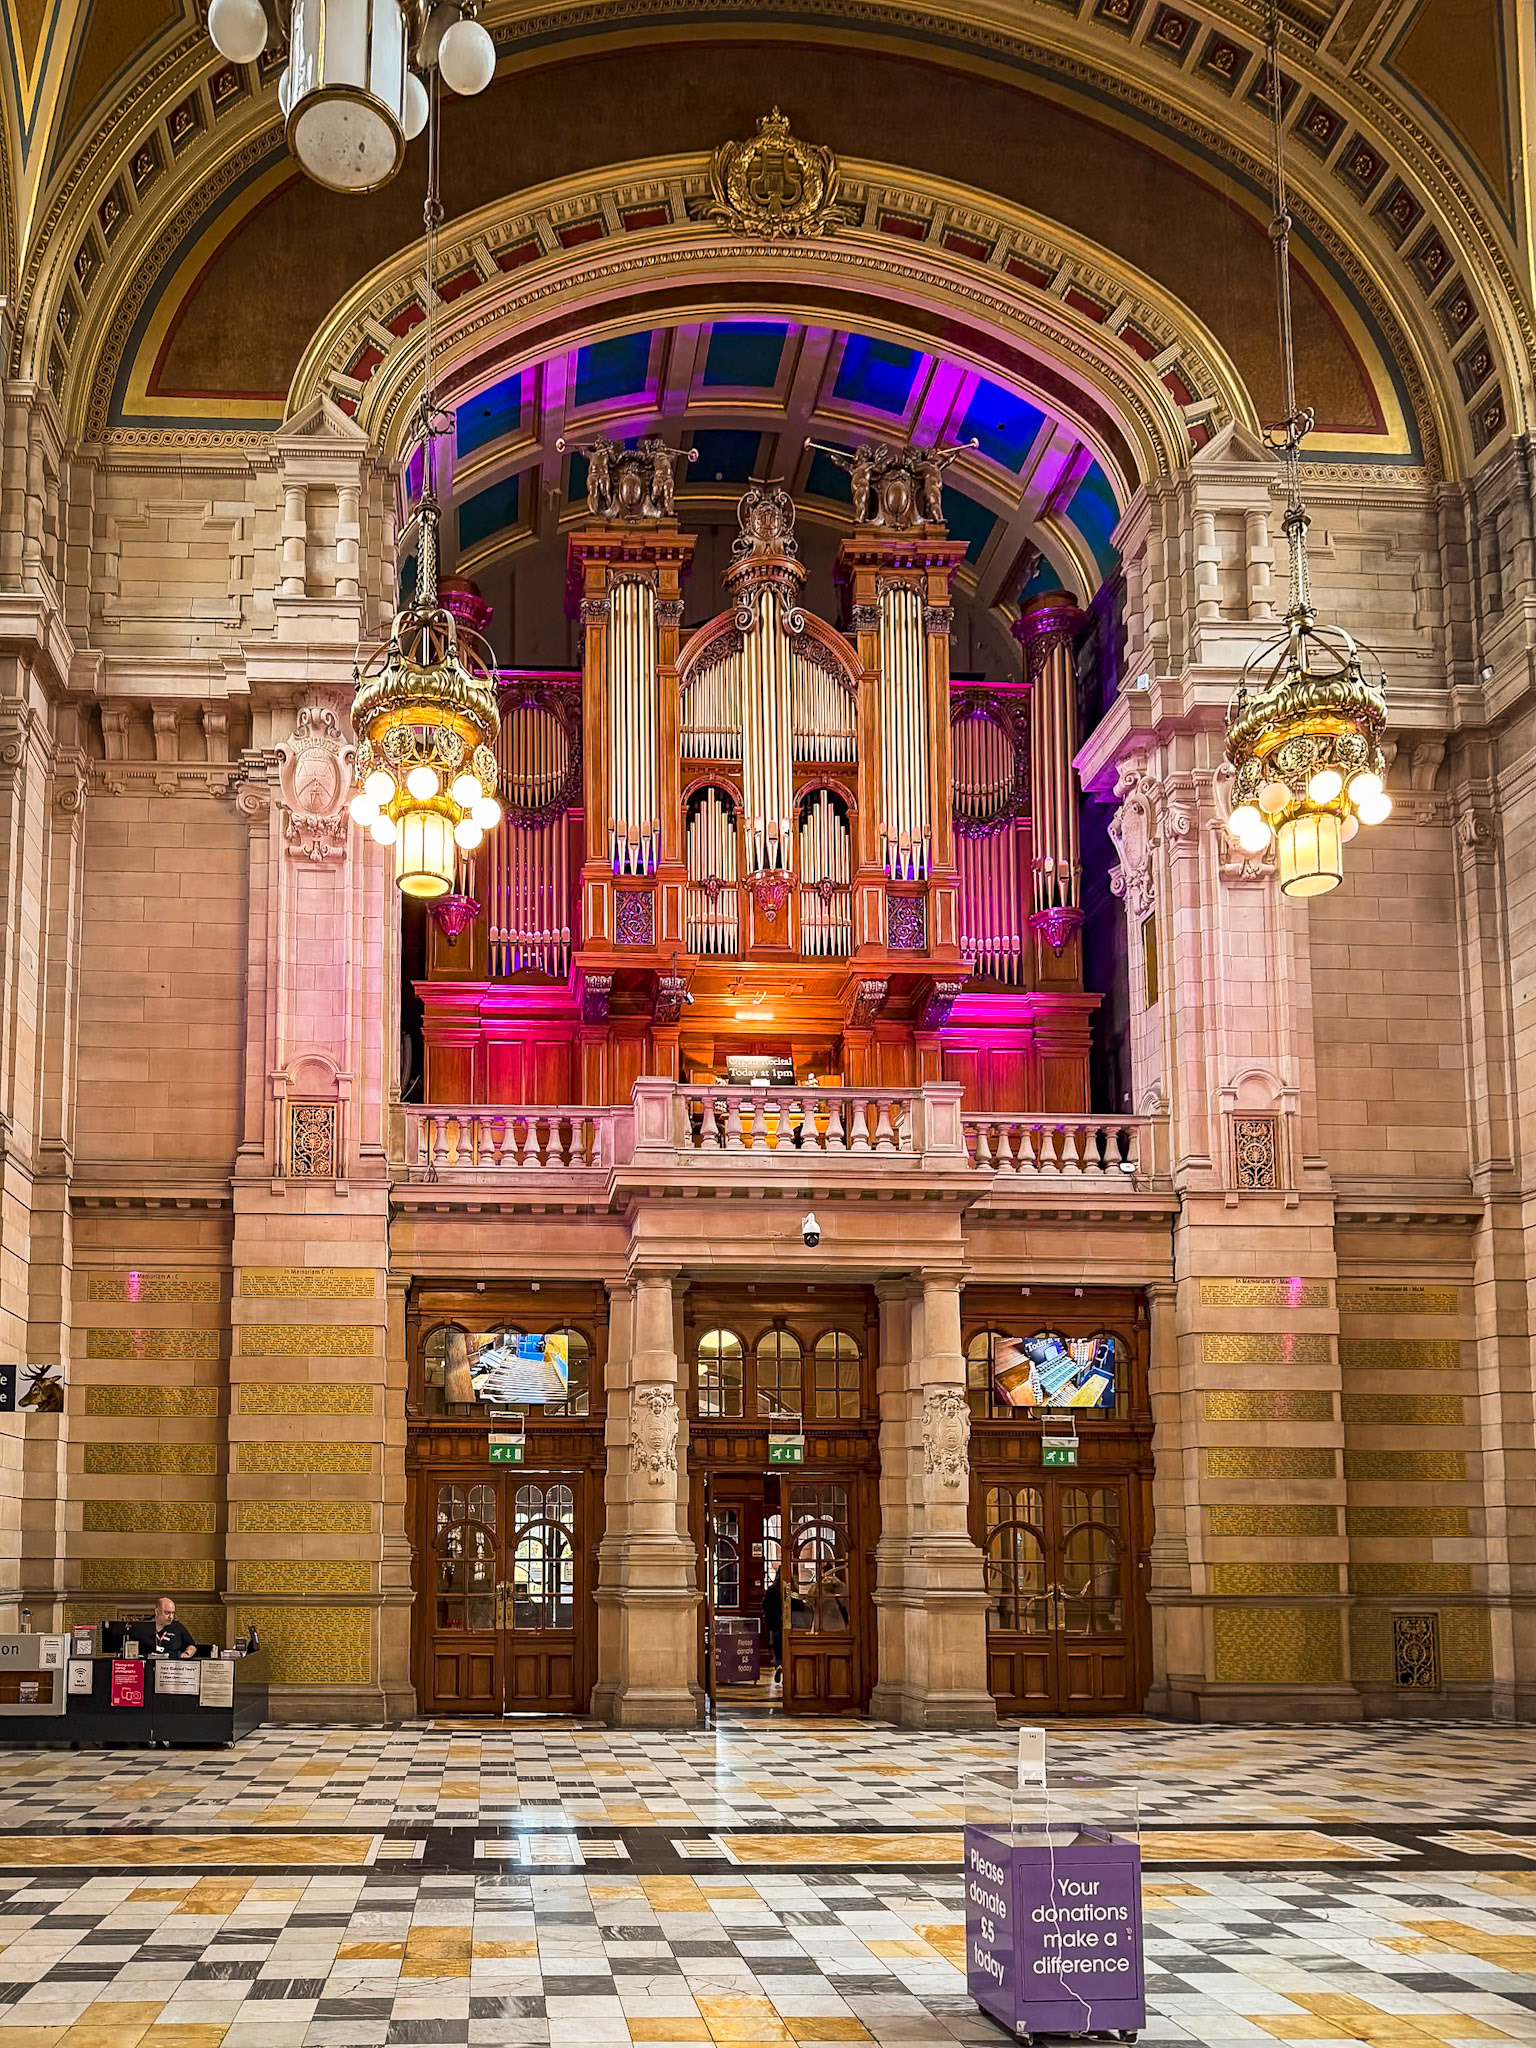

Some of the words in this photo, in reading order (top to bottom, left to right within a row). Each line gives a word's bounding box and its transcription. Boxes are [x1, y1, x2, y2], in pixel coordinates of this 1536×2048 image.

[729, 1067, 758, 1079] Today
[760, 1069, 770, 1077] at
[771, 1068, 794, 1080] 1pm
[970, 1847, 1005, 1886] Please
[1057, 1878, 1100, 1897] Your
[969, 1879, 1007, 1920] donate
[1031, 1903, 1128, 1923] donations
[980, 1916, 996, 1944] £5
[1043, 1929, 1100, 1949] make
[1103, 1932, 1118, 1947] a
[974, 1940, 1006, 1987] today
[1032, 1956, 1130, 1975] difference
